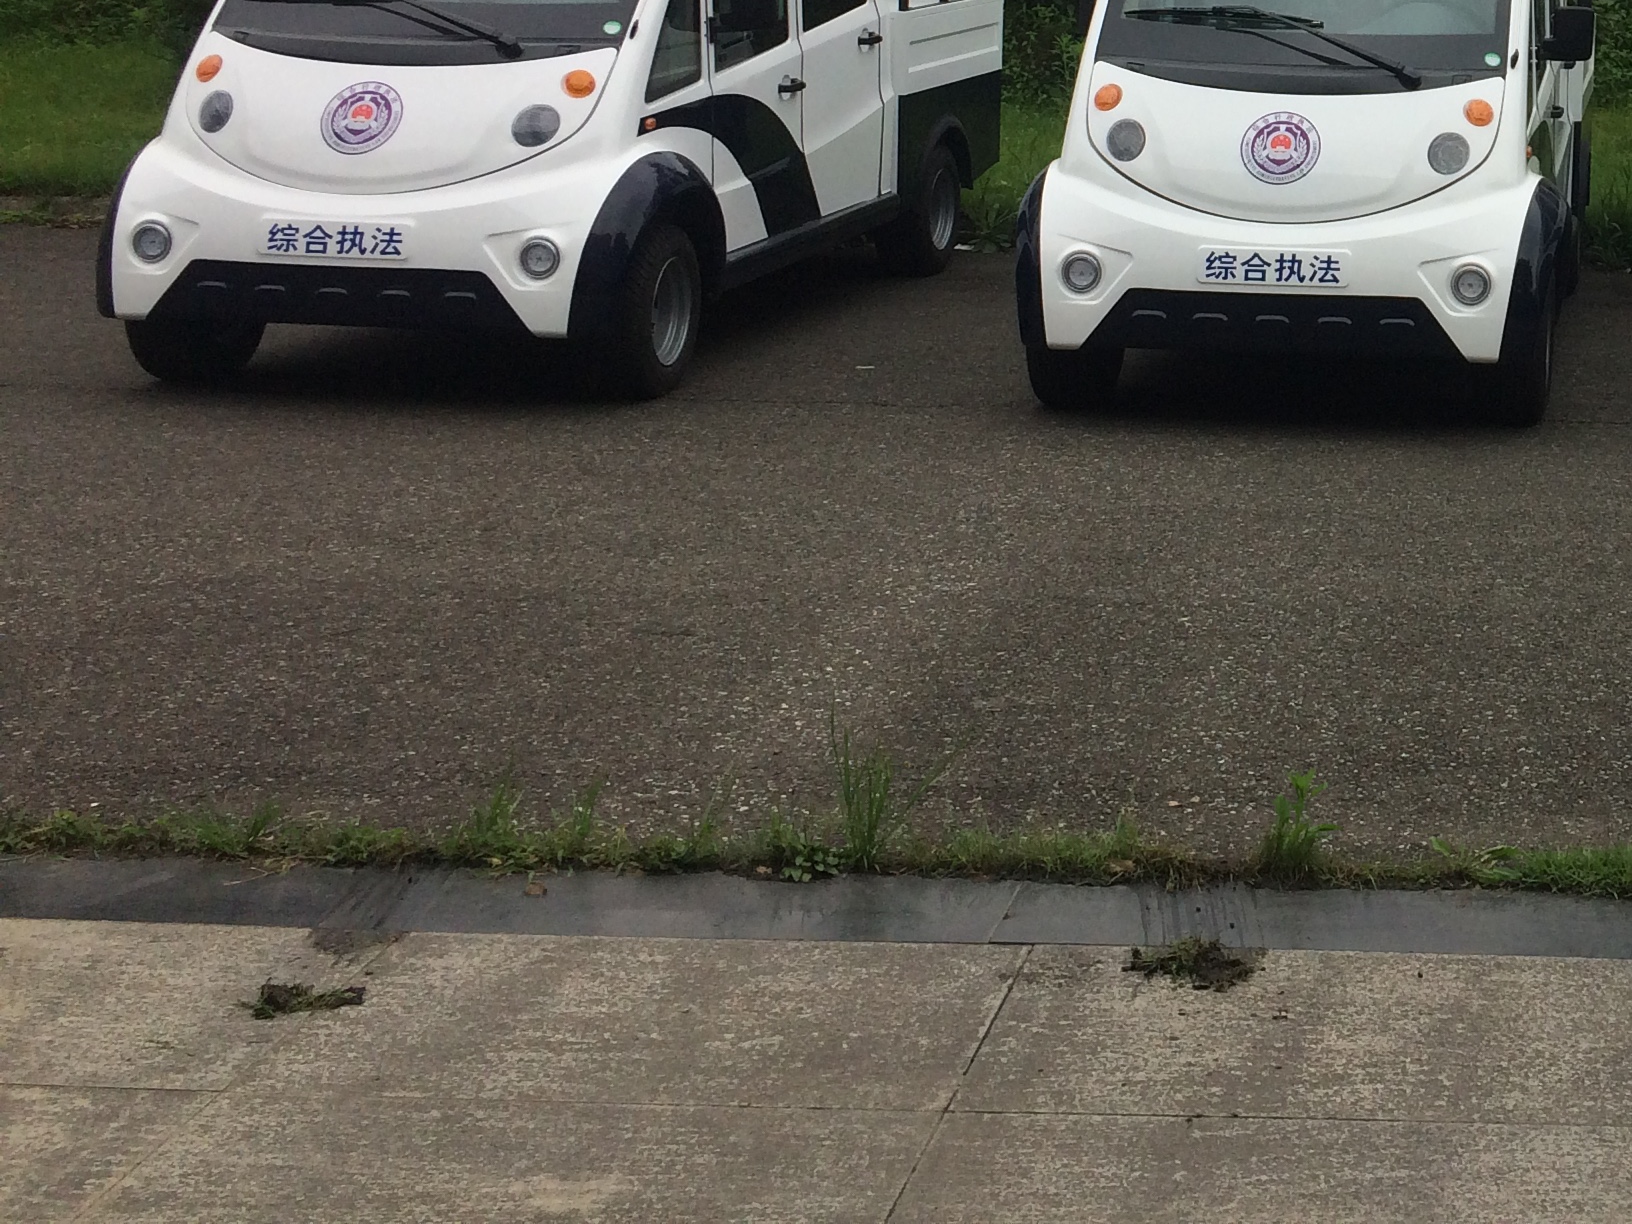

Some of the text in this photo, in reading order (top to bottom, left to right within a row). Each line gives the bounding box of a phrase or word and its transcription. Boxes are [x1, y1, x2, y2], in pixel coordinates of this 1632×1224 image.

[267, 223, 403, 256] 综合执法
[1205, 251, 1341, 284] 综合执法
